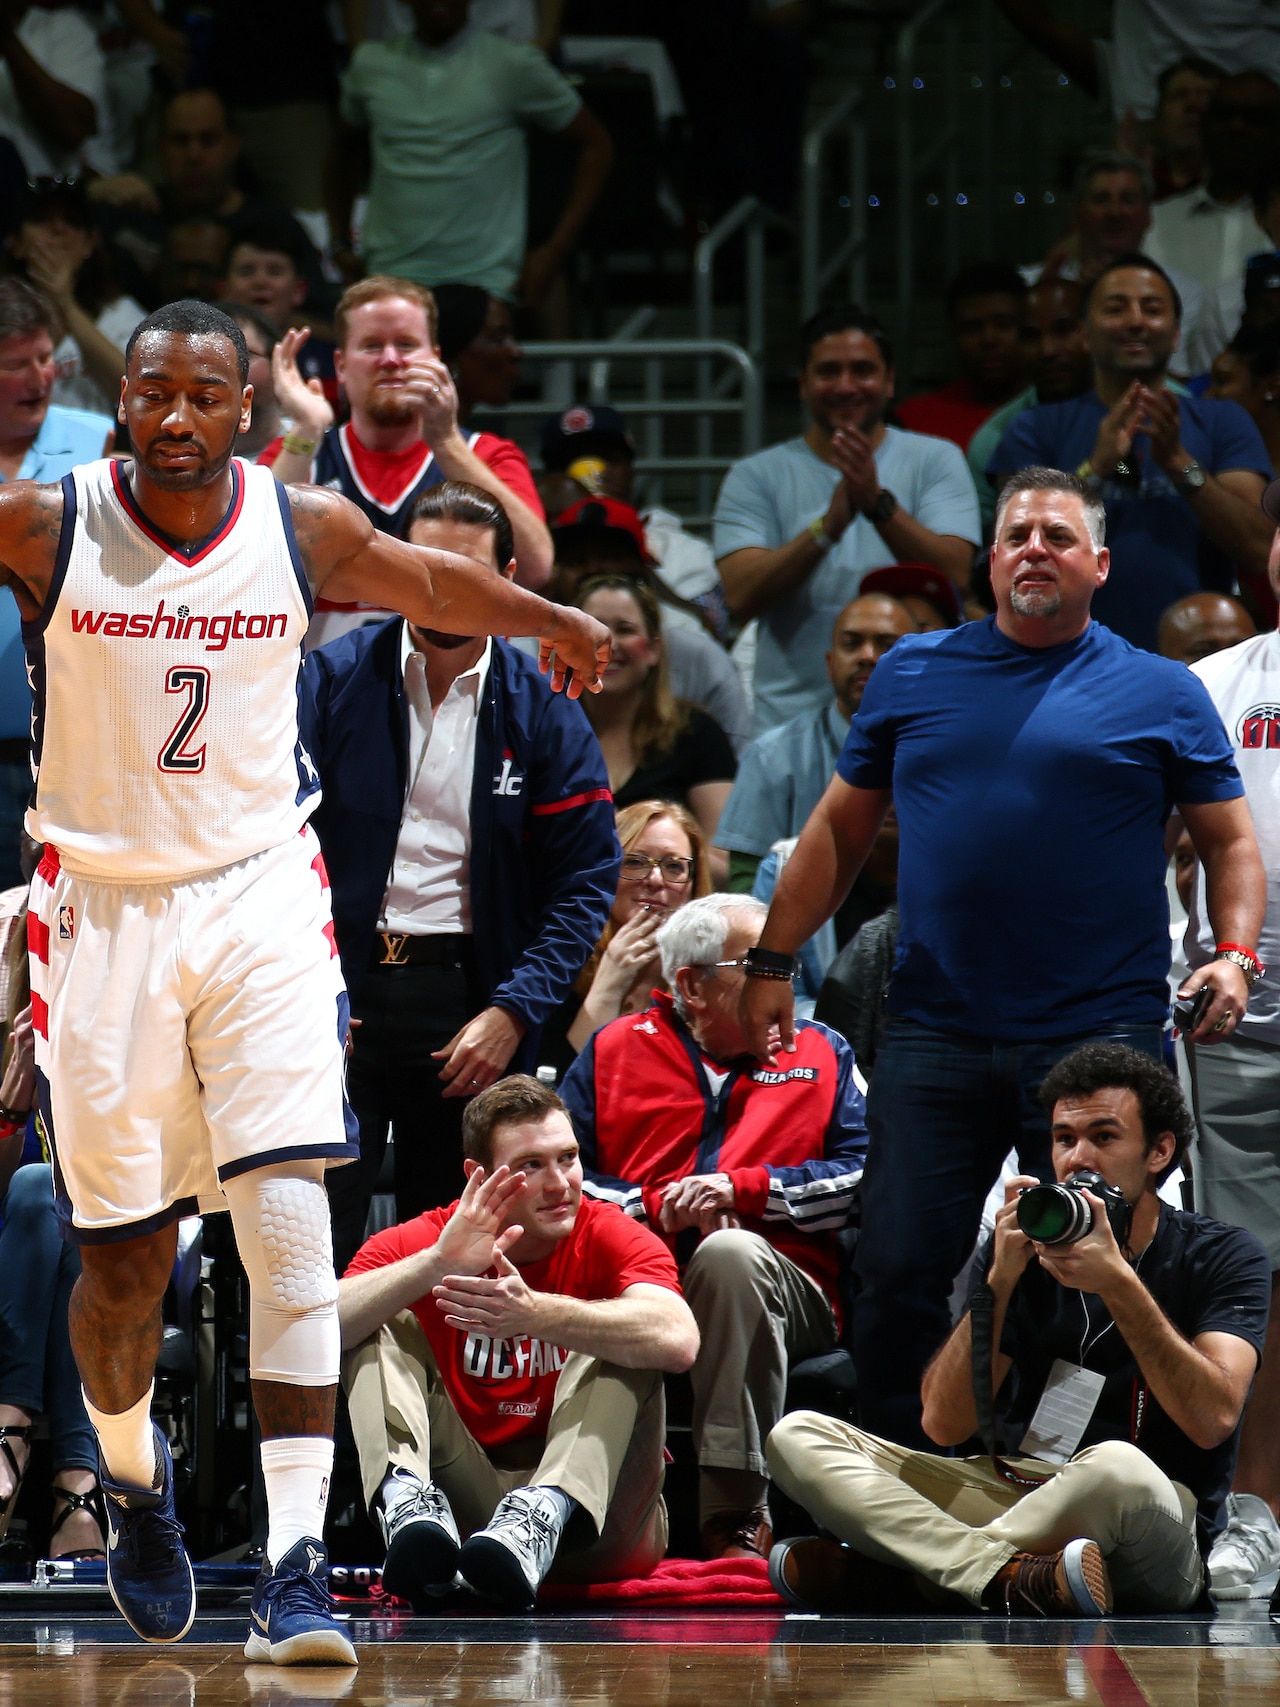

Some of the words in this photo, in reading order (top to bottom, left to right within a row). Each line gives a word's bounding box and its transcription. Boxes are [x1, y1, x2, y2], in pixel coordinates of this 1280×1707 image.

[71, 599, 288, 651] washington
[157, 665, 211, 774] 2
[752, 1067, 814, 1084] WIZARDS
